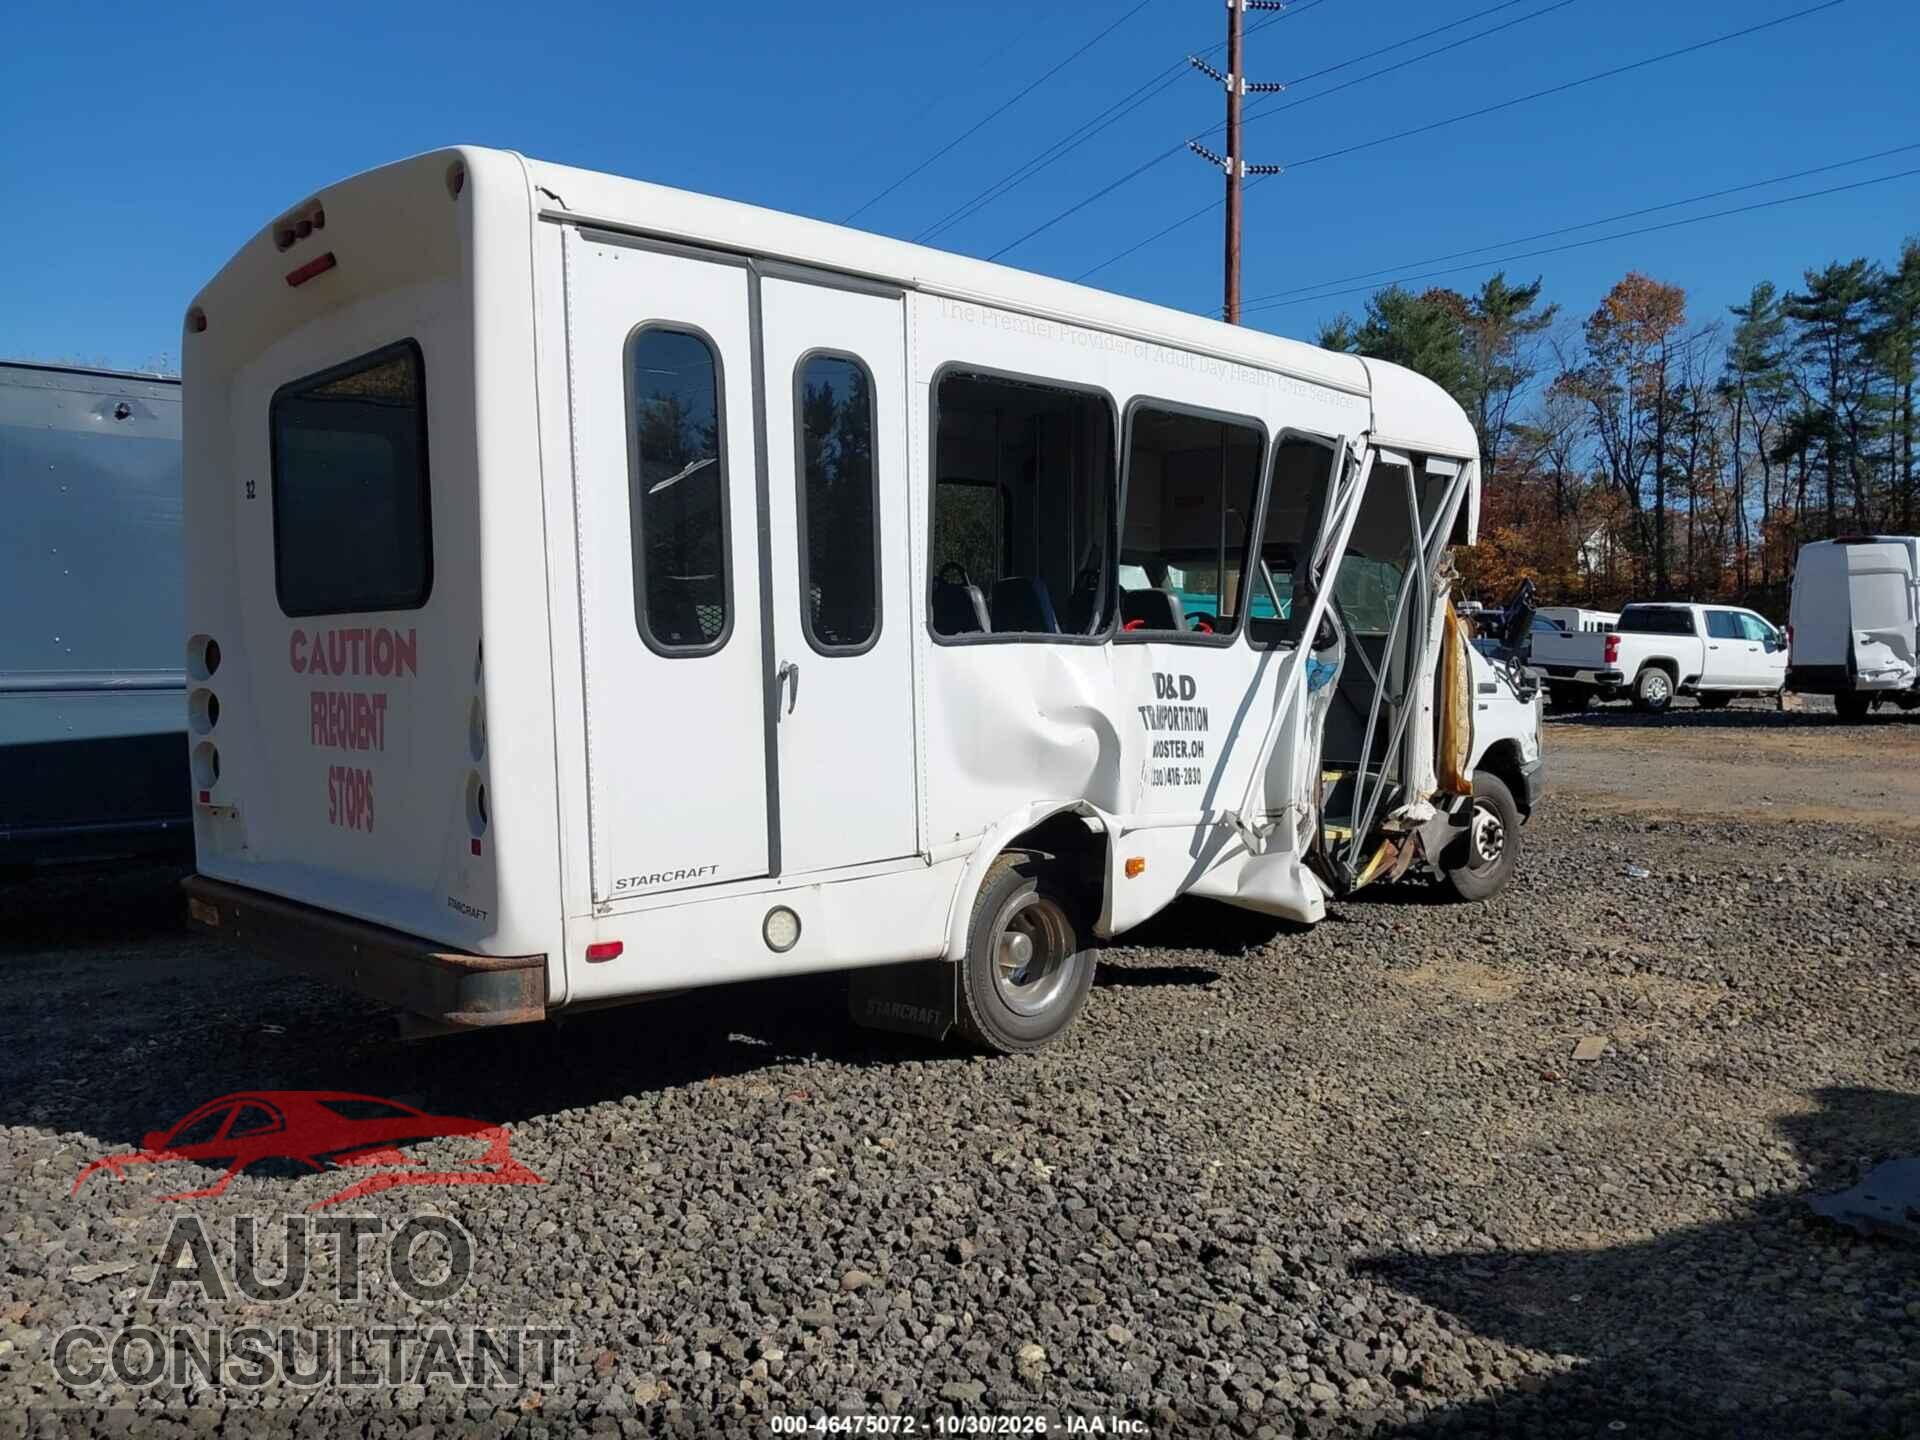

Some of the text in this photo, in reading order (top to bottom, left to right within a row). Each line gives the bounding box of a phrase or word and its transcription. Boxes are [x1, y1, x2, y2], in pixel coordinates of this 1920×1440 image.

[937, 296, 976, 322] The
[1060, 325, 1131, 355] Provider
[1199, 357, 1226, 384] Day
[1230, 365, 1275, 388] Health
[289, 628, 417, 678] CAUTION
[1152, 672, 1197, 701] D&D
[310, 691, 387, 751] FREQUENT
[328, 765, 375, 833] STOPS
[615, 864, 720, 890] STARCRAFT
